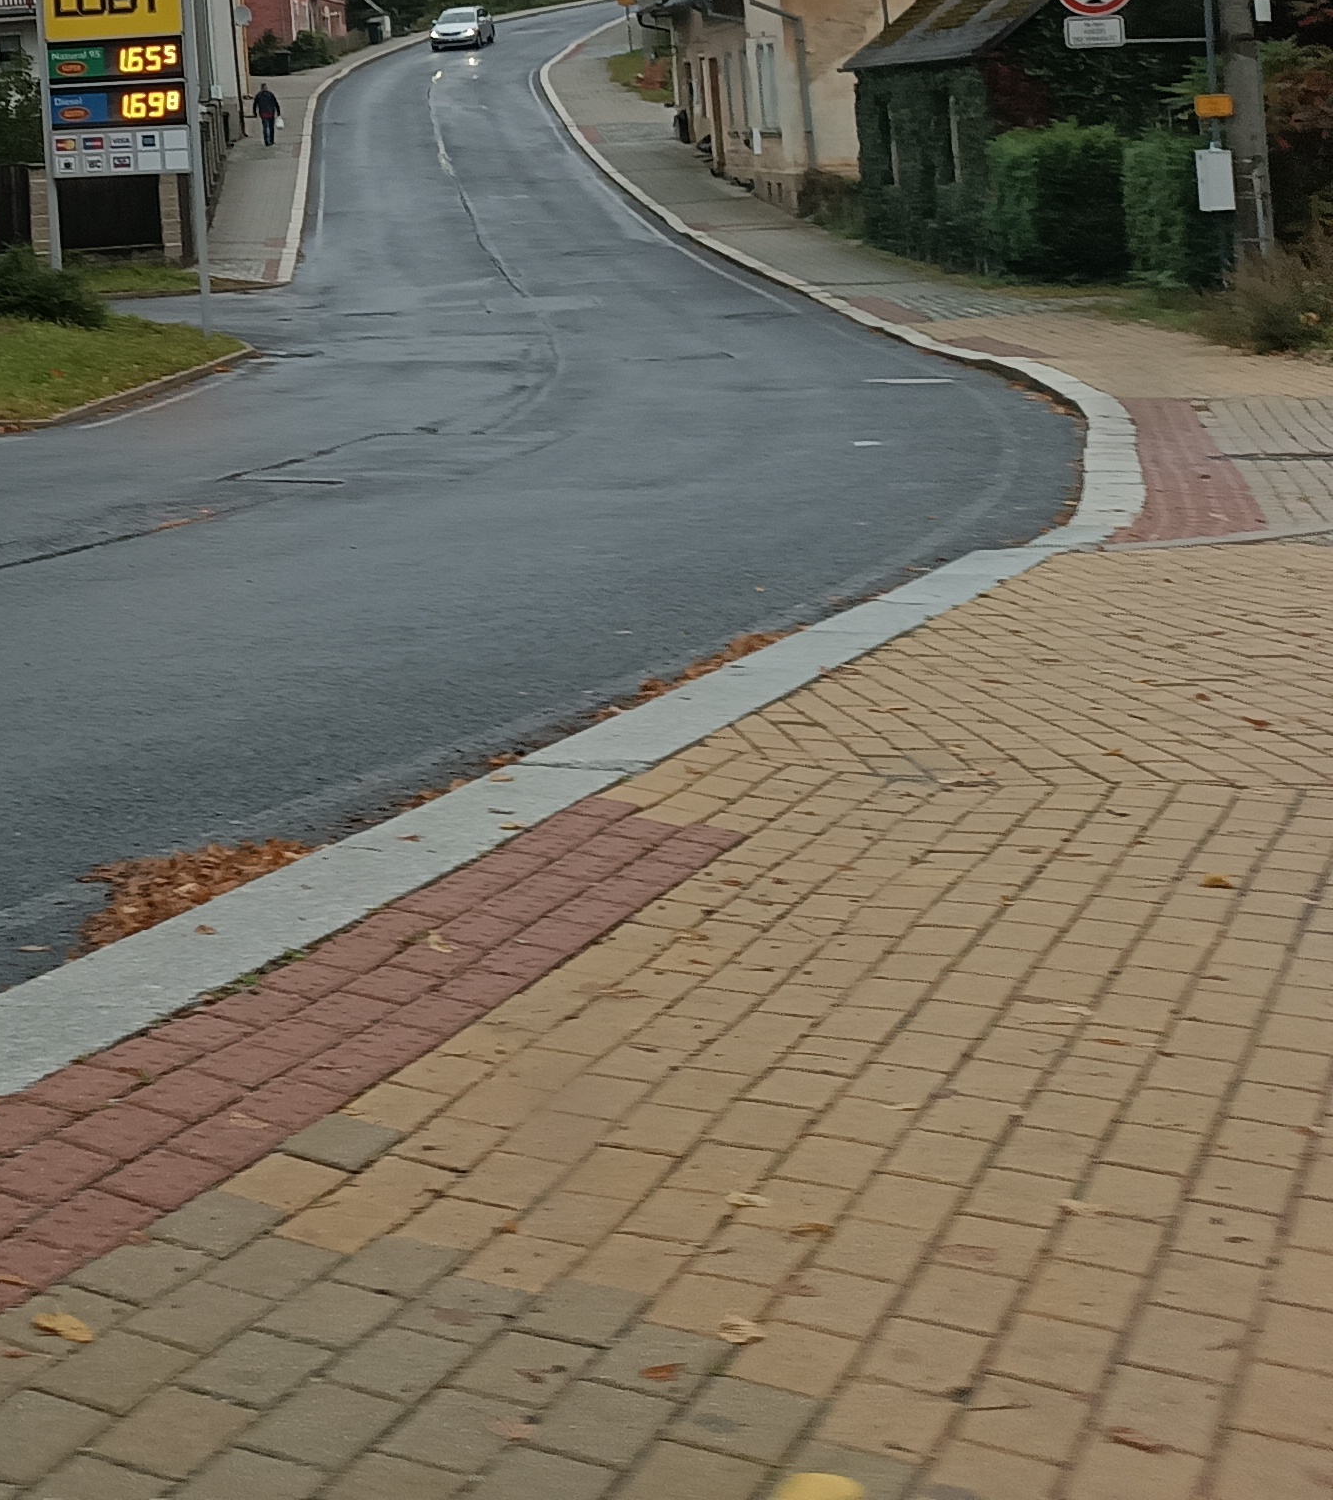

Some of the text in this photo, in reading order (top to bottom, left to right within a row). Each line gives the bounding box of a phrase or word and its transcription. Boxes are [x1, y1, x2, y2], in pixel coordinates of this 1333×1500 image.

[51, 49, 101, 61] Natural 95
[54, 97, 83, 106] Diesel
